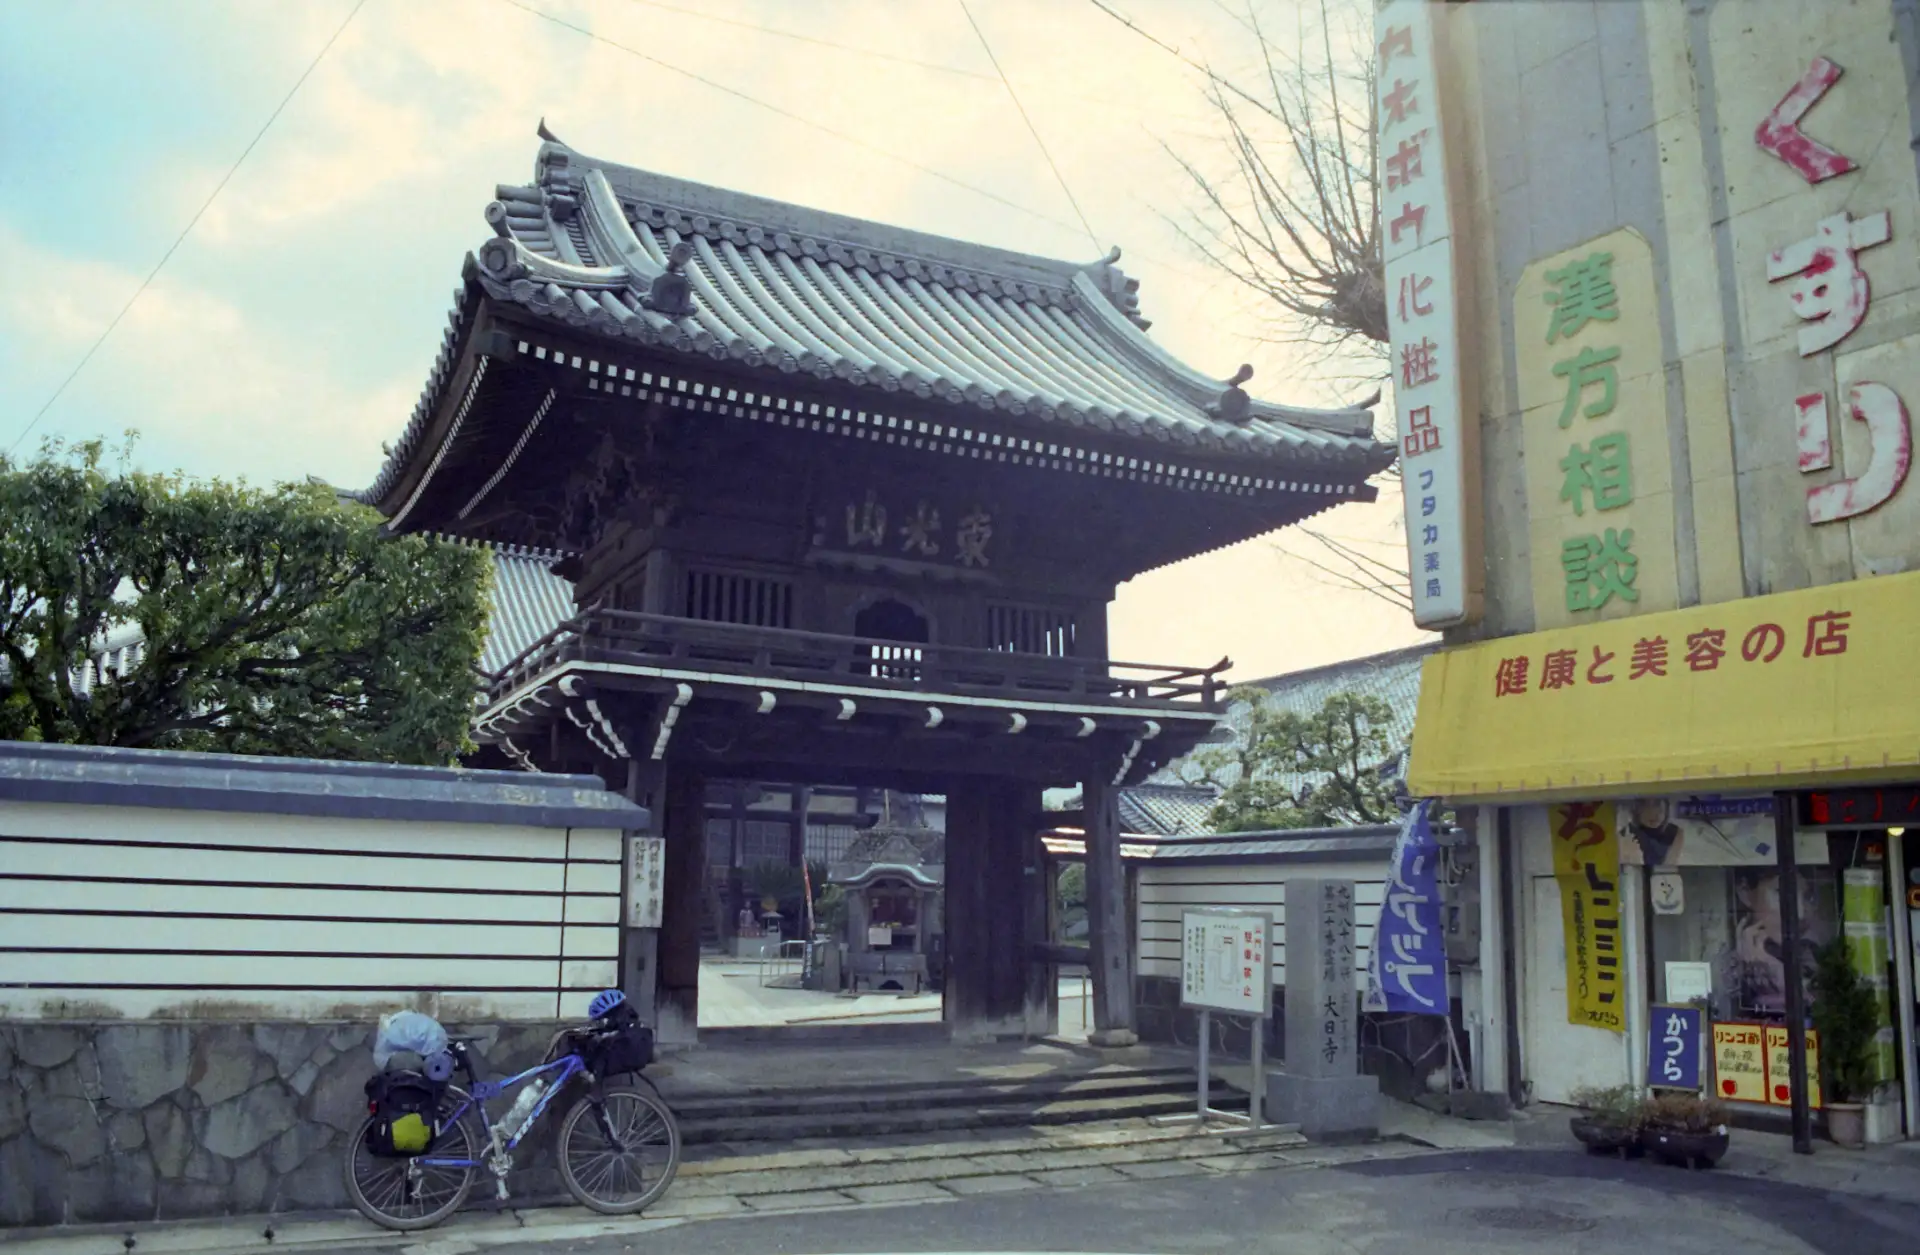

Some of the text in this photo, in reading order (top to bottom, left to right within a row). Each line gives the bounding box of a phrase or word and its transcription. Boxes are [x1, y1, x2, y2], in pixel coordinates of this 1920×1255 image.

[1755, 56, 1912, 526] くすり
[1543, 251, 1640, 613] 漢方相談
[1417, 469, 1443, 600] フタカ薬局
[1494, 610, 1852, 698] 健康と美容の店
[1322, 995, 1340, 1065] 大日寺
[1662, 1012, 1688, 1082] かつら
[1715, 1031, 1760, 1045] リンゴ酢
